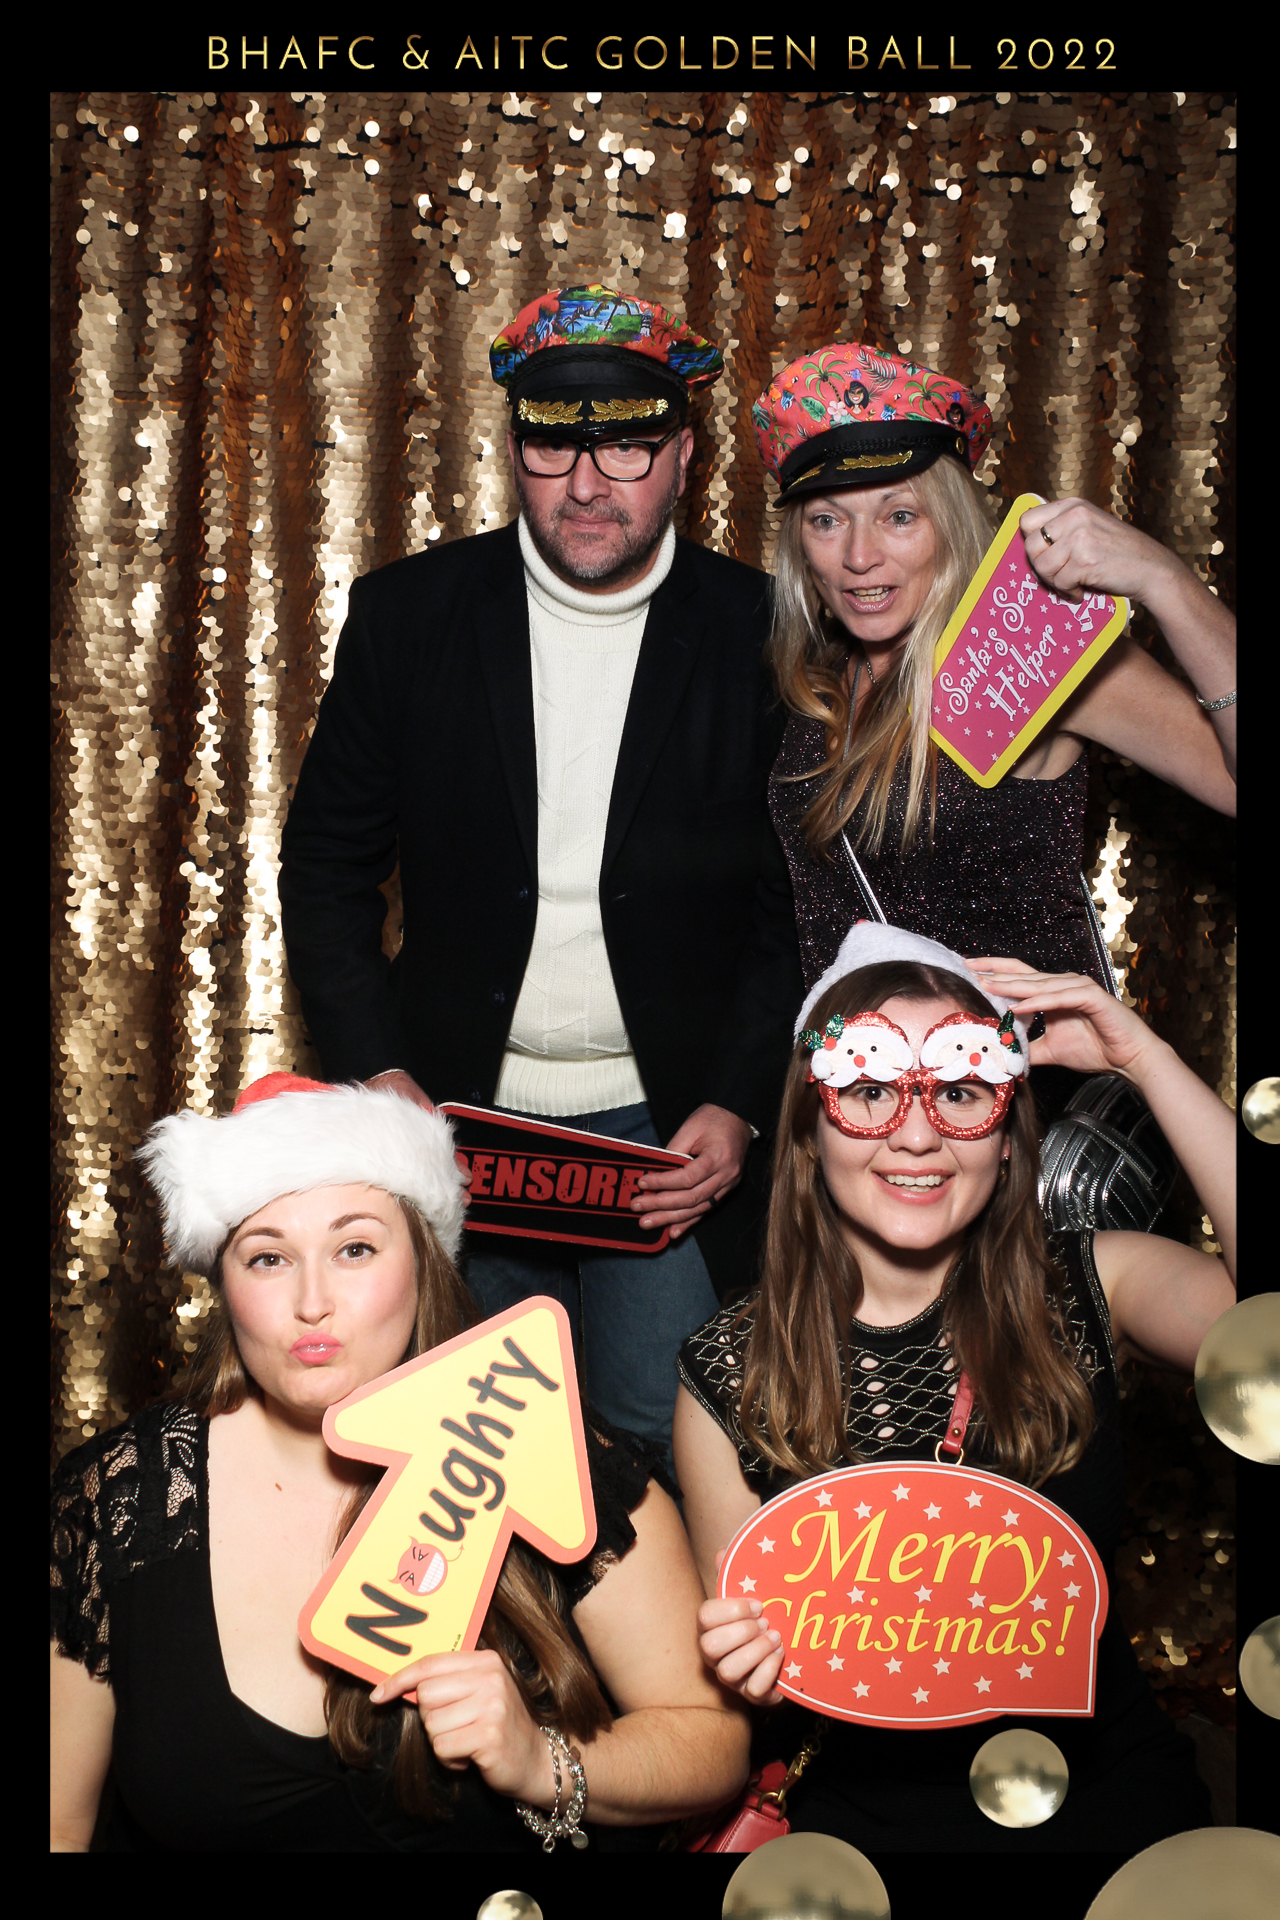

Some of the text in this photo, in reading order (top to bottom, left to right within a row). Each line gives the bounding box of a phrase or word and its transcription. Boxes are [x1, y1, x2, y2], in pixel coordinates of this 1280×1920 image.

[939, 571, 1040, 716] Santa's Sex
[981, 623, 1058, 722] Helper
[457, 1153, 656, 1209] ENSORE
[783, 1508, 1053, 1615] Merry
